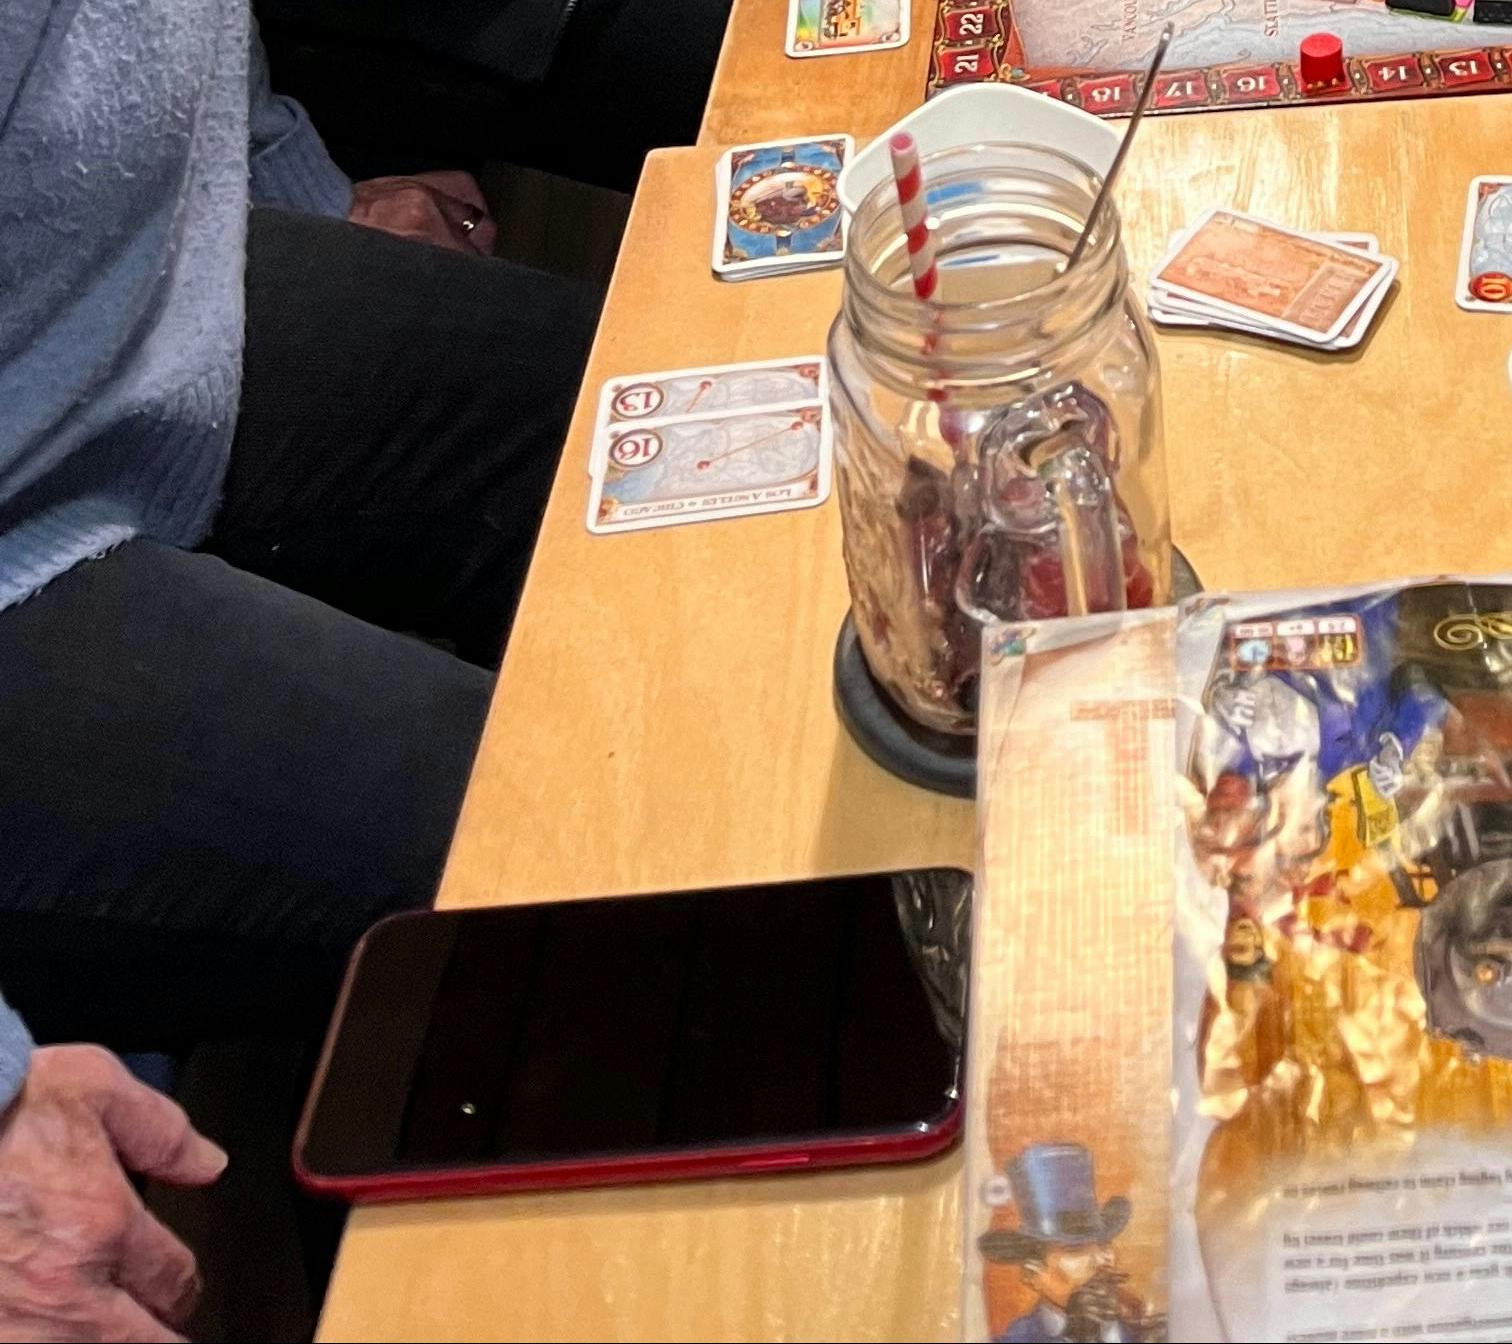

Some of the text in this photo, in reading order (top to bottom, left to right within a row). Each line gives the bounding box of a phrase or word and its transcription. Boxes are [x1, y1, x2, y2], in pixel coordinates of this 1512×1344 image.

[959, 13, 984, 35] 22
[954, 54, 979, 73] 21
[1448, 60, 1478, 77] 13
[1381, 65, 1407, 81] 14
[1166, 81, 1193, 97] 17
[1236, 75, 1265, 91] 16
[1091, 86, 1121, 102] 18
[1481, 276, 1510, 299] 10
[620, 391, 657, 414] 13
[617, 436, 654, 459] 16
[700, 490, 763, 507] ANGELES
[764, 487, 793, 501] LOS
